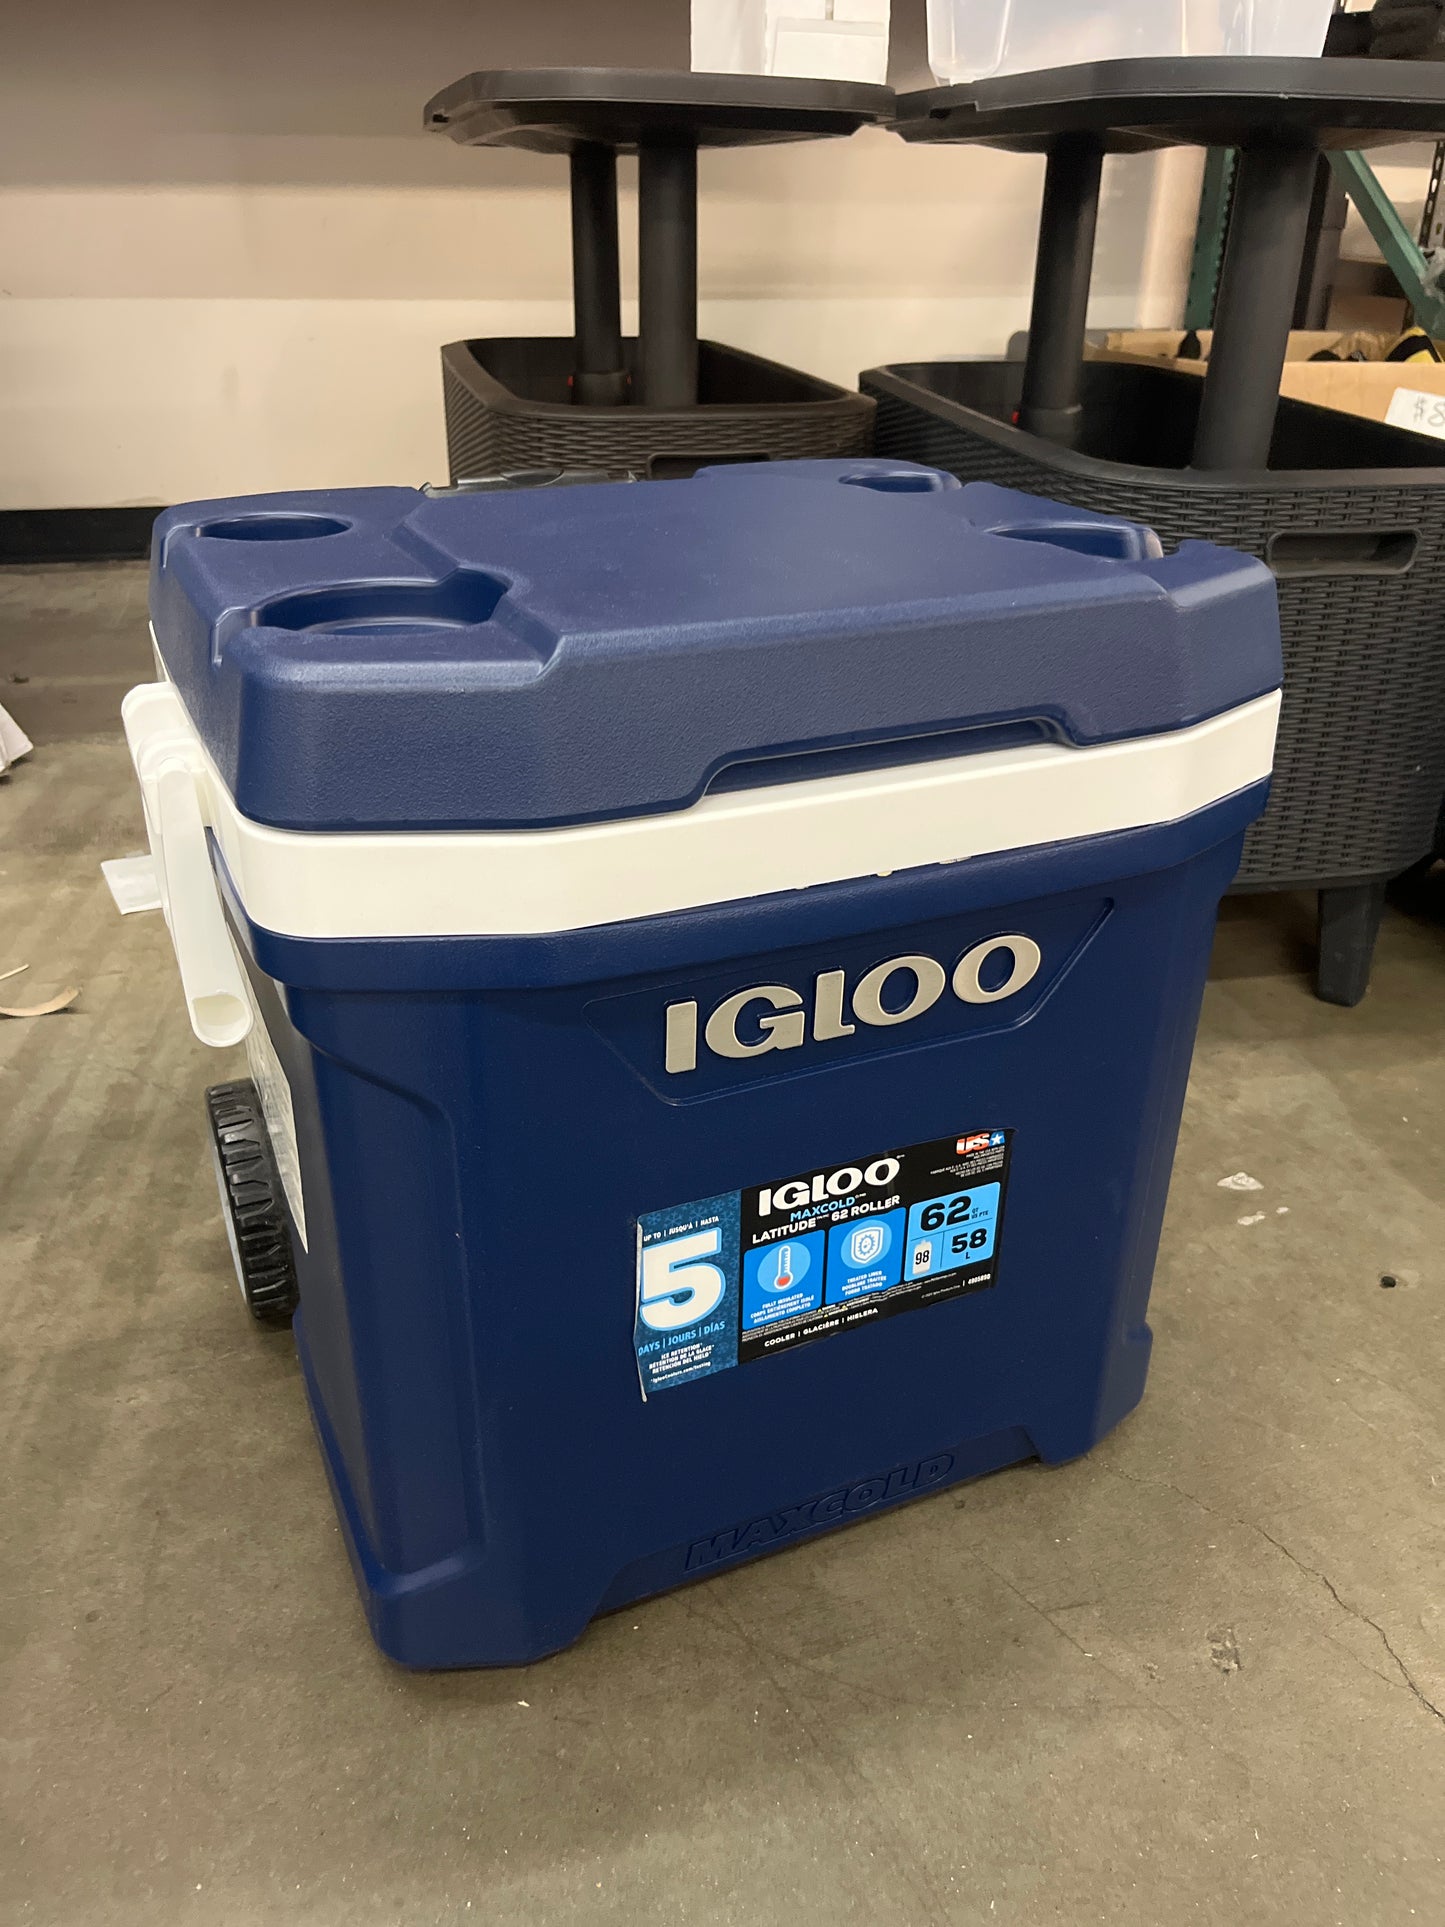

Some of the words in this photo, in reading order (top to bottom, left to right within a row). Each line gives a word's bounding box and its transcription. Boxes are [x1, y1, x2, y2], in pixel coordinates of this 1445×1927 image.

[665, 933, 1042, 1074] IGLOO
[758, 1157, 900, 1217] IGLOO
[752, 1217, 817, 1244] LATITUDE
[831, 1209, 849, 1222] 62
[851, 1194, 900, 1217] ROLLER
[790, 1196, 855, 1223] MAXCOLD
[920, 1195, 972, 1231] 62
[643, 1234, 652, 1242] UP
[700, 1216, 719, 1226] HASTA
[951, 1228, 987, 1254] 58
[915, 1250, 930, 1265] 98
[965, 1252, 970, 1260] L
[639, 1227, 726, 1331] 5
[638, 1341, 660, 1357] DAYS
[668, 1329, 696, 1346] JOURS
[704, 1320, 725, 1335] DÍAS
[764, 1333, 796, 1347] COOLER
[803, 1318, 840, 1335] GLACIÈRE
[847, 1307, 879, 1322] HIELERA
[661, 1352, 670, 1360] ICE
[684, 1453, 954, 1574] MAXCOLD
